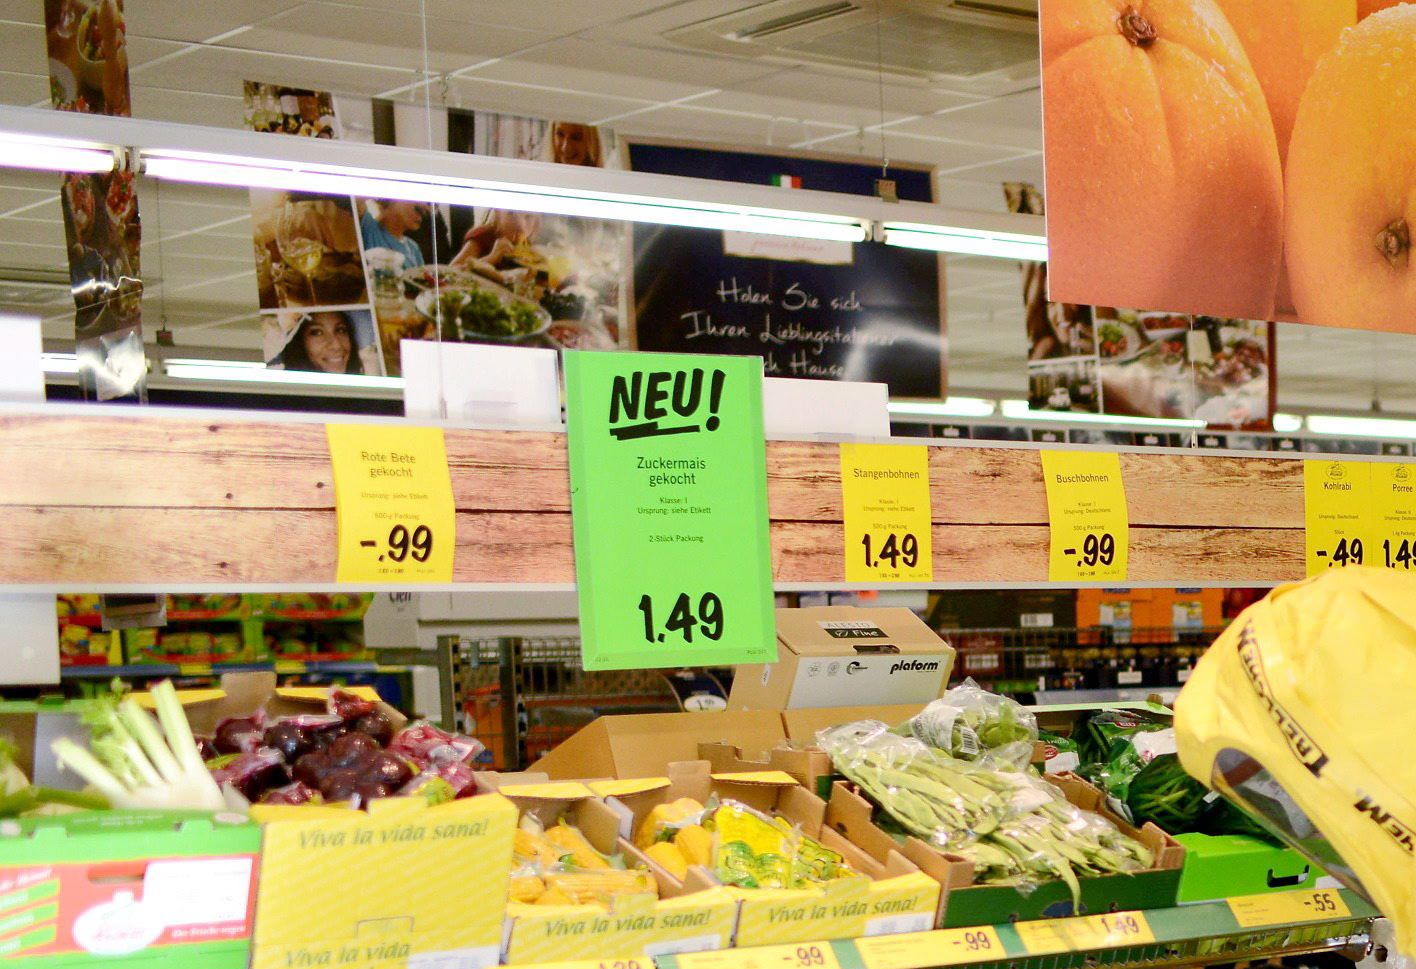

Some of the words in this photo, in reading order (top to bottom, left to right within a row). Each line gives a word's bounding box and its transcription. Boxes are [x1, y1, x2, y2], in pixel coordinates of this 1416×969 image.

[782, 282, 820, 310] Sie
[681, 310, 750, 340] Ihren
[609, 368, 727, 432] NEU!
[361, 451, 387, 464] Rote
[391, 452, 416, 464] Bete
[637, 456, 706, 470] Zuckermais
[370, 465, 414, 478] gekocht
[649, 473, 696, 487] gekocht
[853, 468, 920, 480] Stangenbohnen
[1056, 473, 1109, 484] Buschbohnen
[1323, 481, 1352, 491] Kohlrabi
[1392, 483, 1413, 493] Porree
[360, 524, 434, 563] -.99
[676, 535, 704, 543] Packung
[862, 533, 919, 569] 1.49
[1064, 533, 1115, 567] -.99
[1316, 538, 1363, 567] -.49
[638, 592, 724, 644] 1.49
[852, 629, 879, 637] Fine
[890, 660, 939, 675] plaform
[299, 829, 346, 849] Viva
[352, 828, 373, 845] la
[381, 824, 426, 843] vida
[432, 819, 489, 841] sana!
[768, 906, 804, 923] Viva
[809, 904, 826, 920] la
[831, 900, 872, 917] vida
[877, 896, 918, 914] sana!
[546, 920, 585, 937] Viva
[592, 917, 608, 932] la
[616, 914, 657, 931] vida
[660, 911, 710, 928] sana!
[952, 930, 991, 951] -.99
[286, 951, 332, 968] Viva
[339, 947, 358, 962] la
[366, 943, 411, 960] vida
[782, 946, 825, 967] -.99
